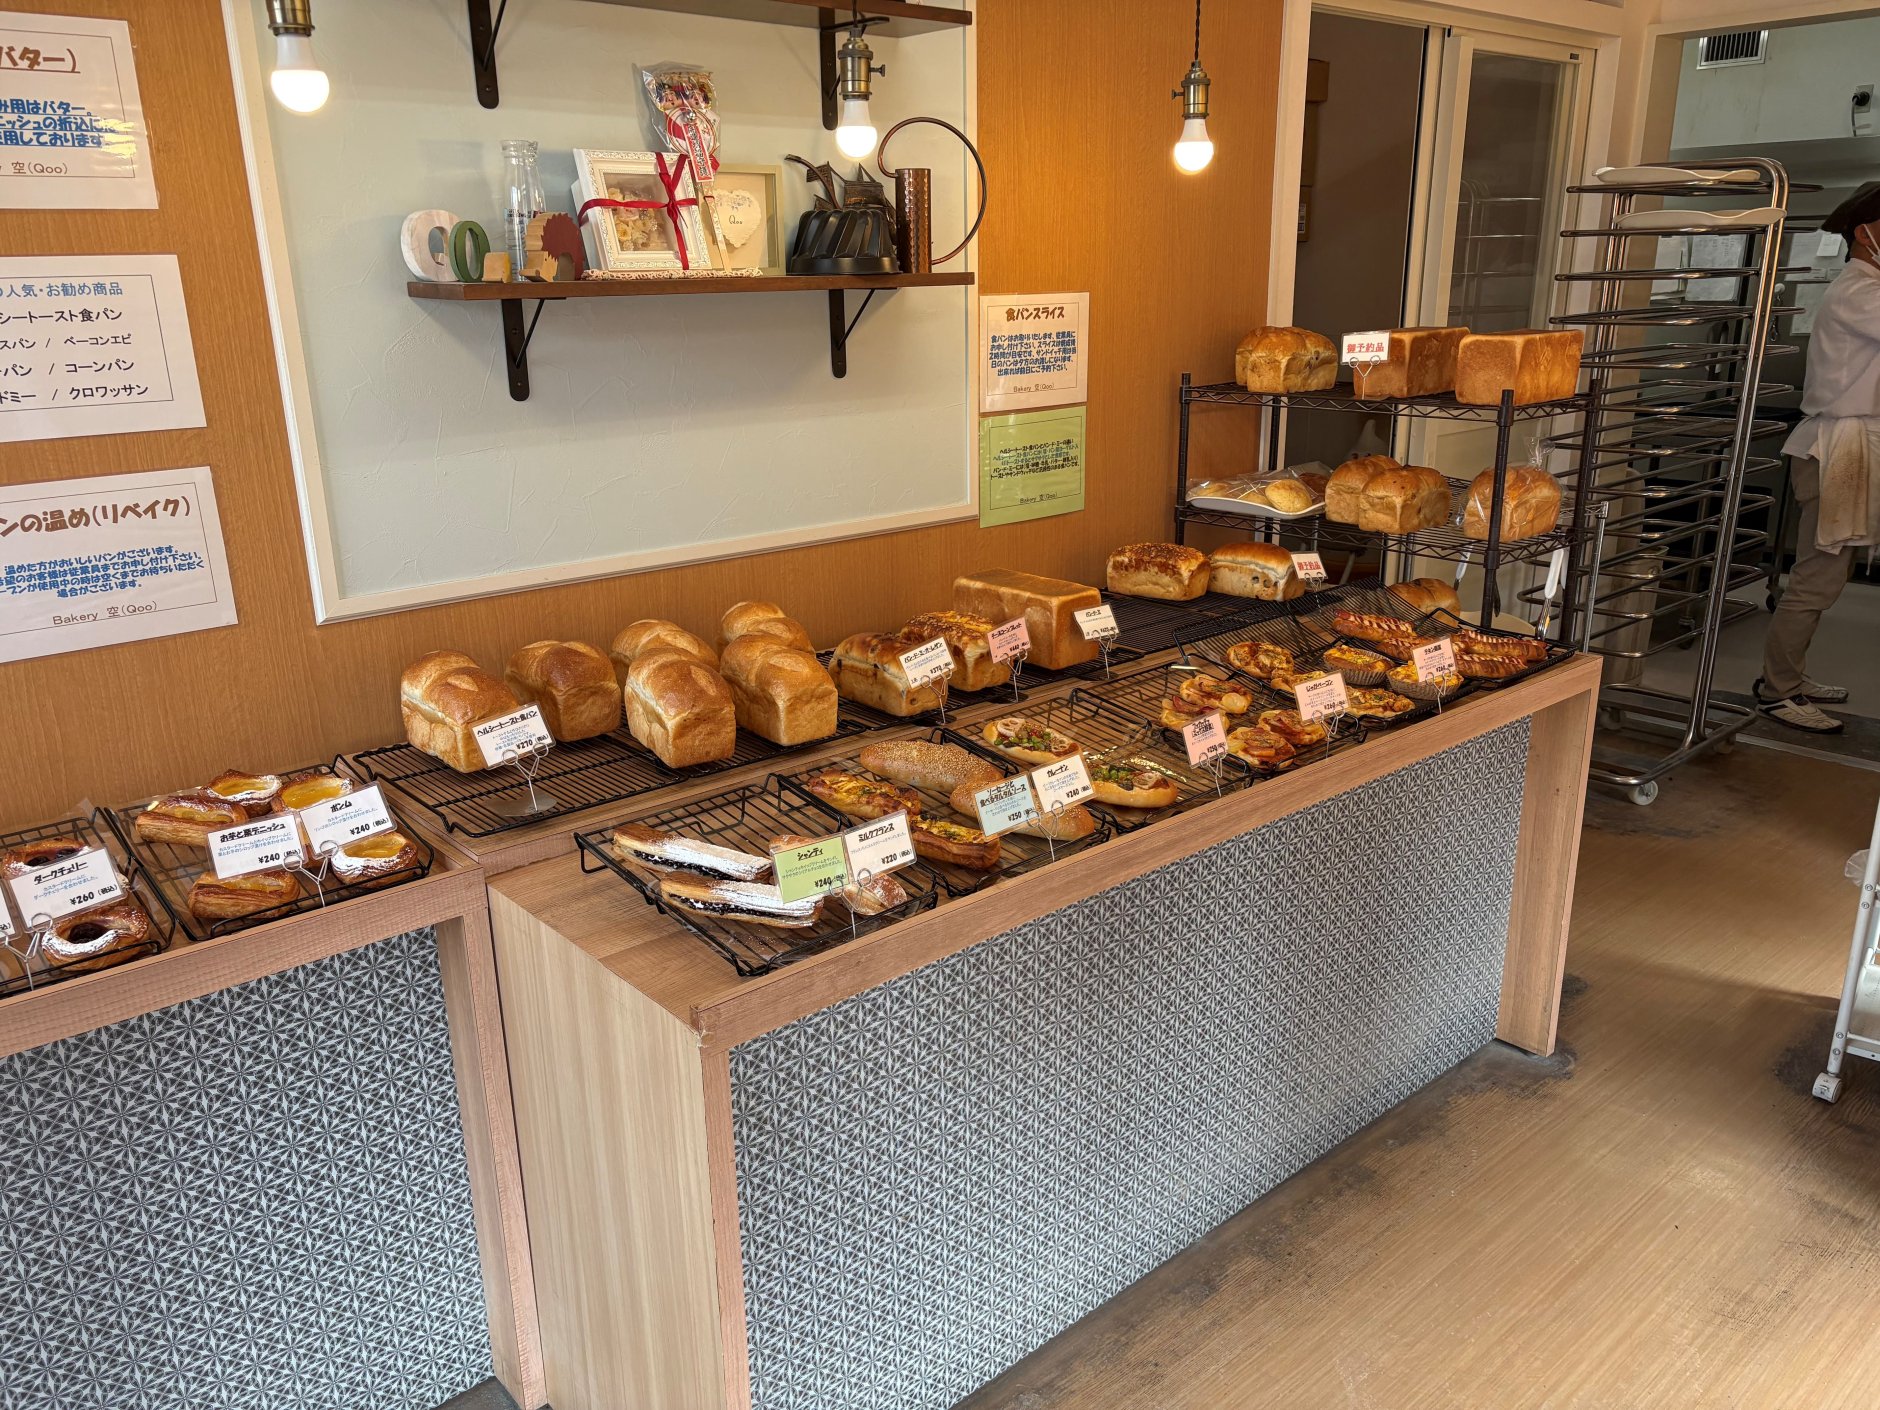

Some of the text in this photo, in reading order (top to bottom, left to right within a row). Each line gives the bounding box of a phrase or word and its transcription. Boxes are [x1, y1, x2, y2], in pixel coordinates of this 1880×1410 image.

[0, 281, 123, 297] 人気・お勧め商品
[1005, 306, 1065, 322] 食パンスライス
[65, 359, 134, 374] コーンパン
[69, 384, 149, 400] クロワッサン
[53, 612, 98, 626] Bakery
[516, 739, 533, 750] ¥270
[1066, 788, 1079, 799] ¥240
[1008, 811, 1022, 822] ¥250
[350, 824, 370, 836] ¥240
[258, 853, 280, 864] ¥240
[881, 853, 897, 865] ¥220
[34, 862, 88, 883] ダークチェリー
[70, 891, 94, 905] ¥260
